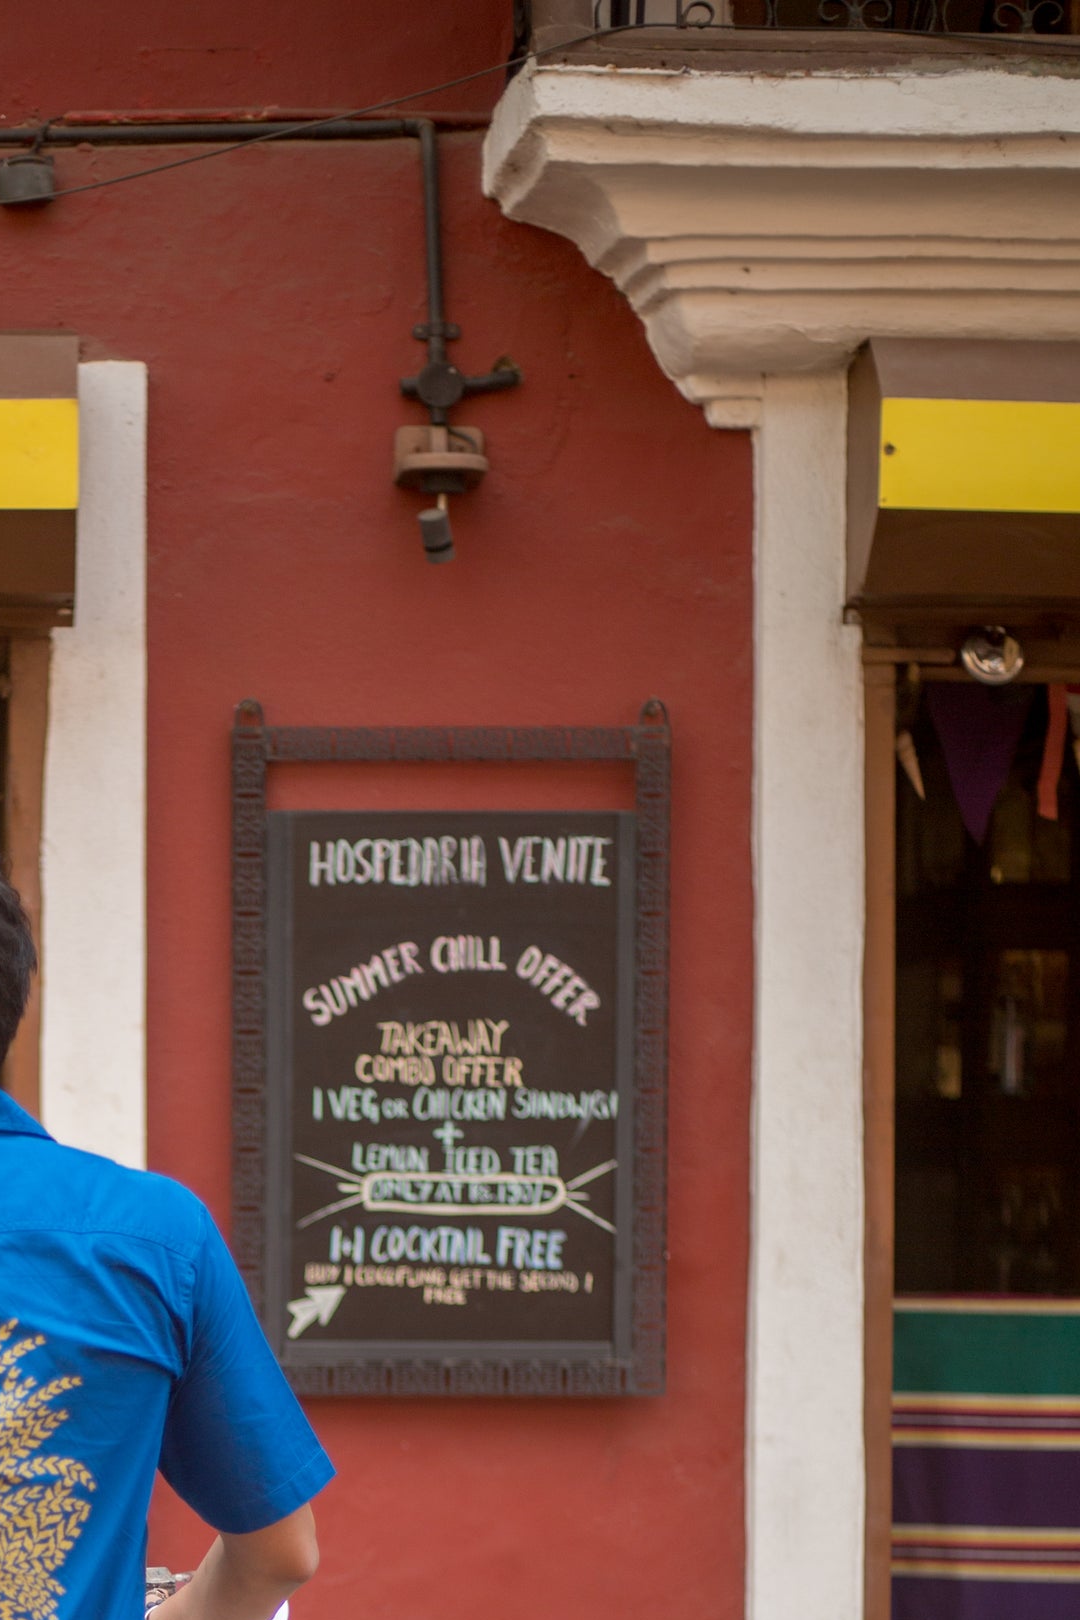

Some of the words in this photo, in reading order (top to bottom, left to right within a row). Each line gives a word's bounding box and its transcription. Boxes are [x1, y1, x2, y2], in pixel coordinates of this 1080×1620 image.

[498, 835, 614, 886] VENITE
[303, 941, 423, 1026] SUMMER
[430, 935, 507, 973] CHILL
[516, 945, 601, 1026] OFFER
[377, 1018, 510, 1056] TAKEAWAY
[355, 1054, 436, 1086] COMBO
[442, 1055, 524, 1088] OFFER
[328, 1086, 380, 1124] VEG
[413, 1086, 507, 1121] CHICKEN
[442, 1145, 501, 1175] ICED
[509, 1145, 559, 1176] TEA
[370, 1225, 492, 1265] COCKTAIL
[496, 1225, 568, 1270] FREE
